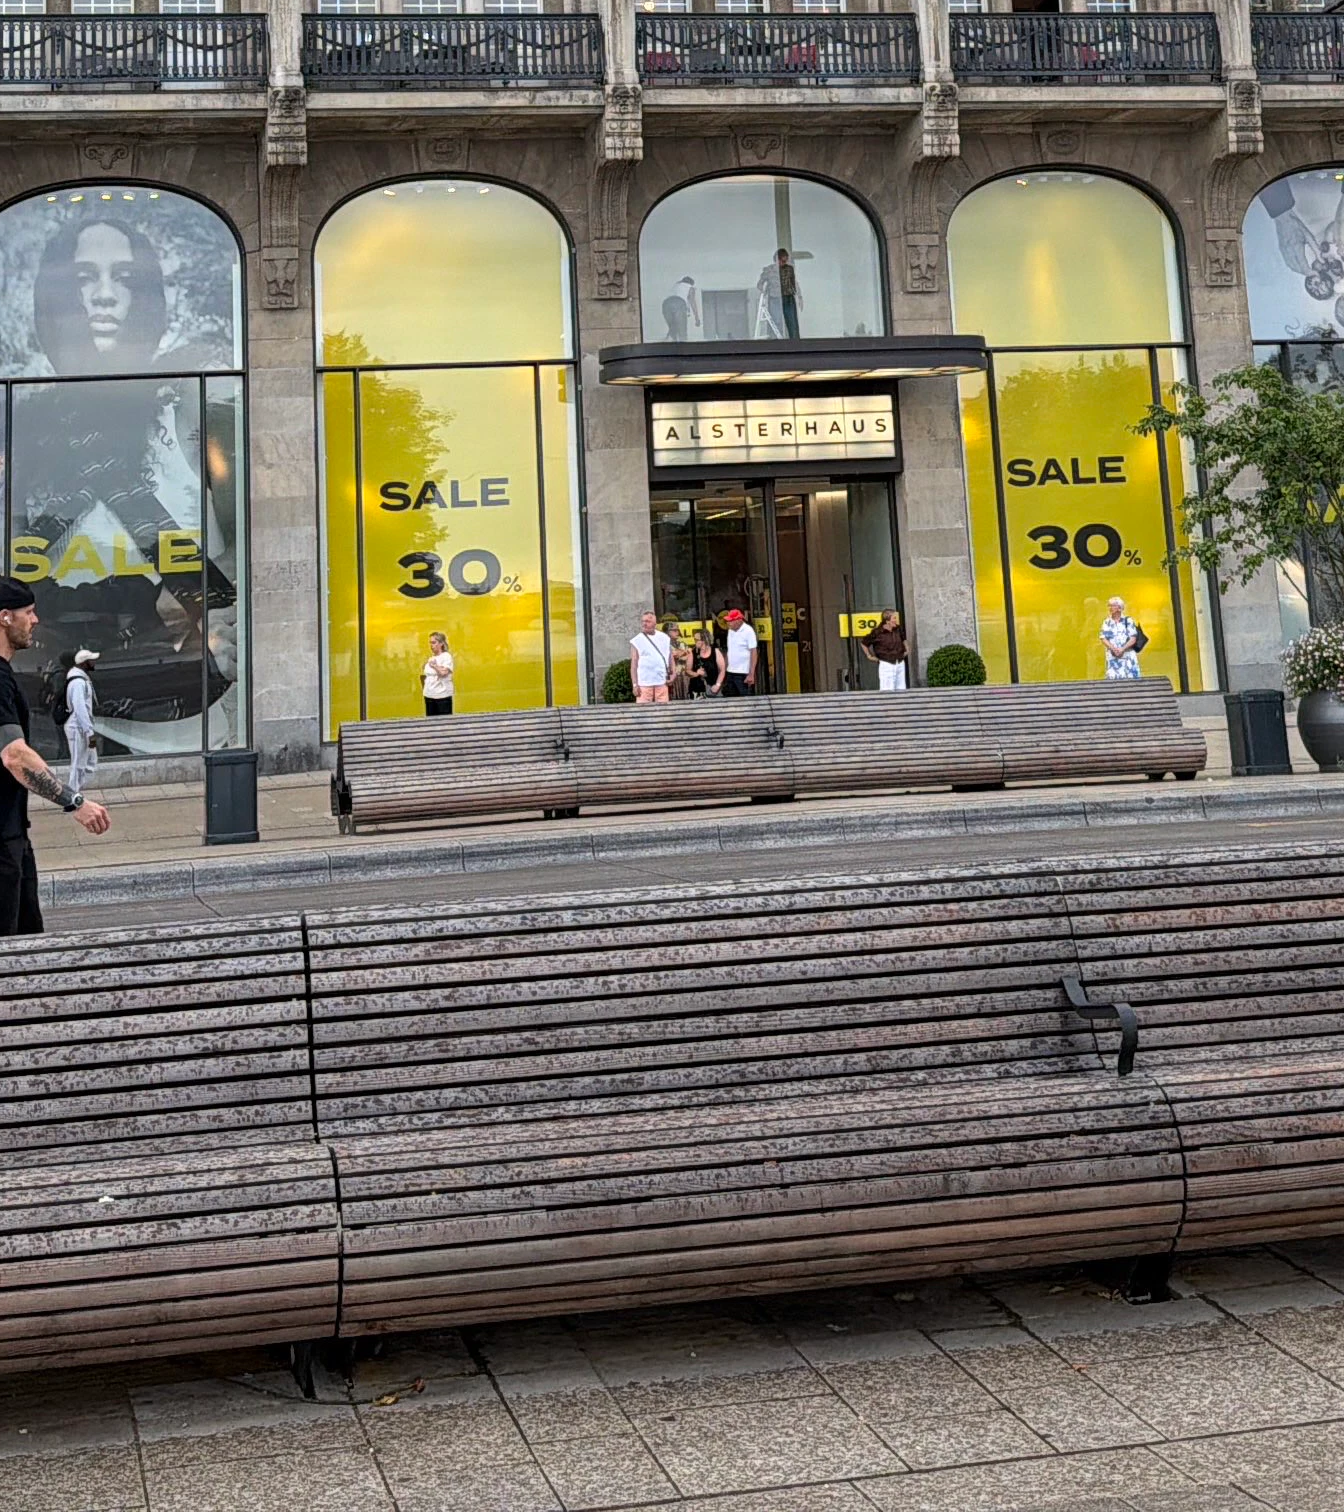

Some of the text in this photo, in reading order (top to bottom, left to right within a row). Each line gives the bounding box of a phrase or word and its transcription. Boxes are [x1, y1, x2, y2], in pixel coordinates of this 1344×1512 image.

[665, 418, 888, 441] ALSTERHAUS
[1007, 456, 1127, 487] SALE
[379, 478, 511, 511] SALE
[1, 529, 204, 583] SALE
[858, 619, 877, 629] 30
